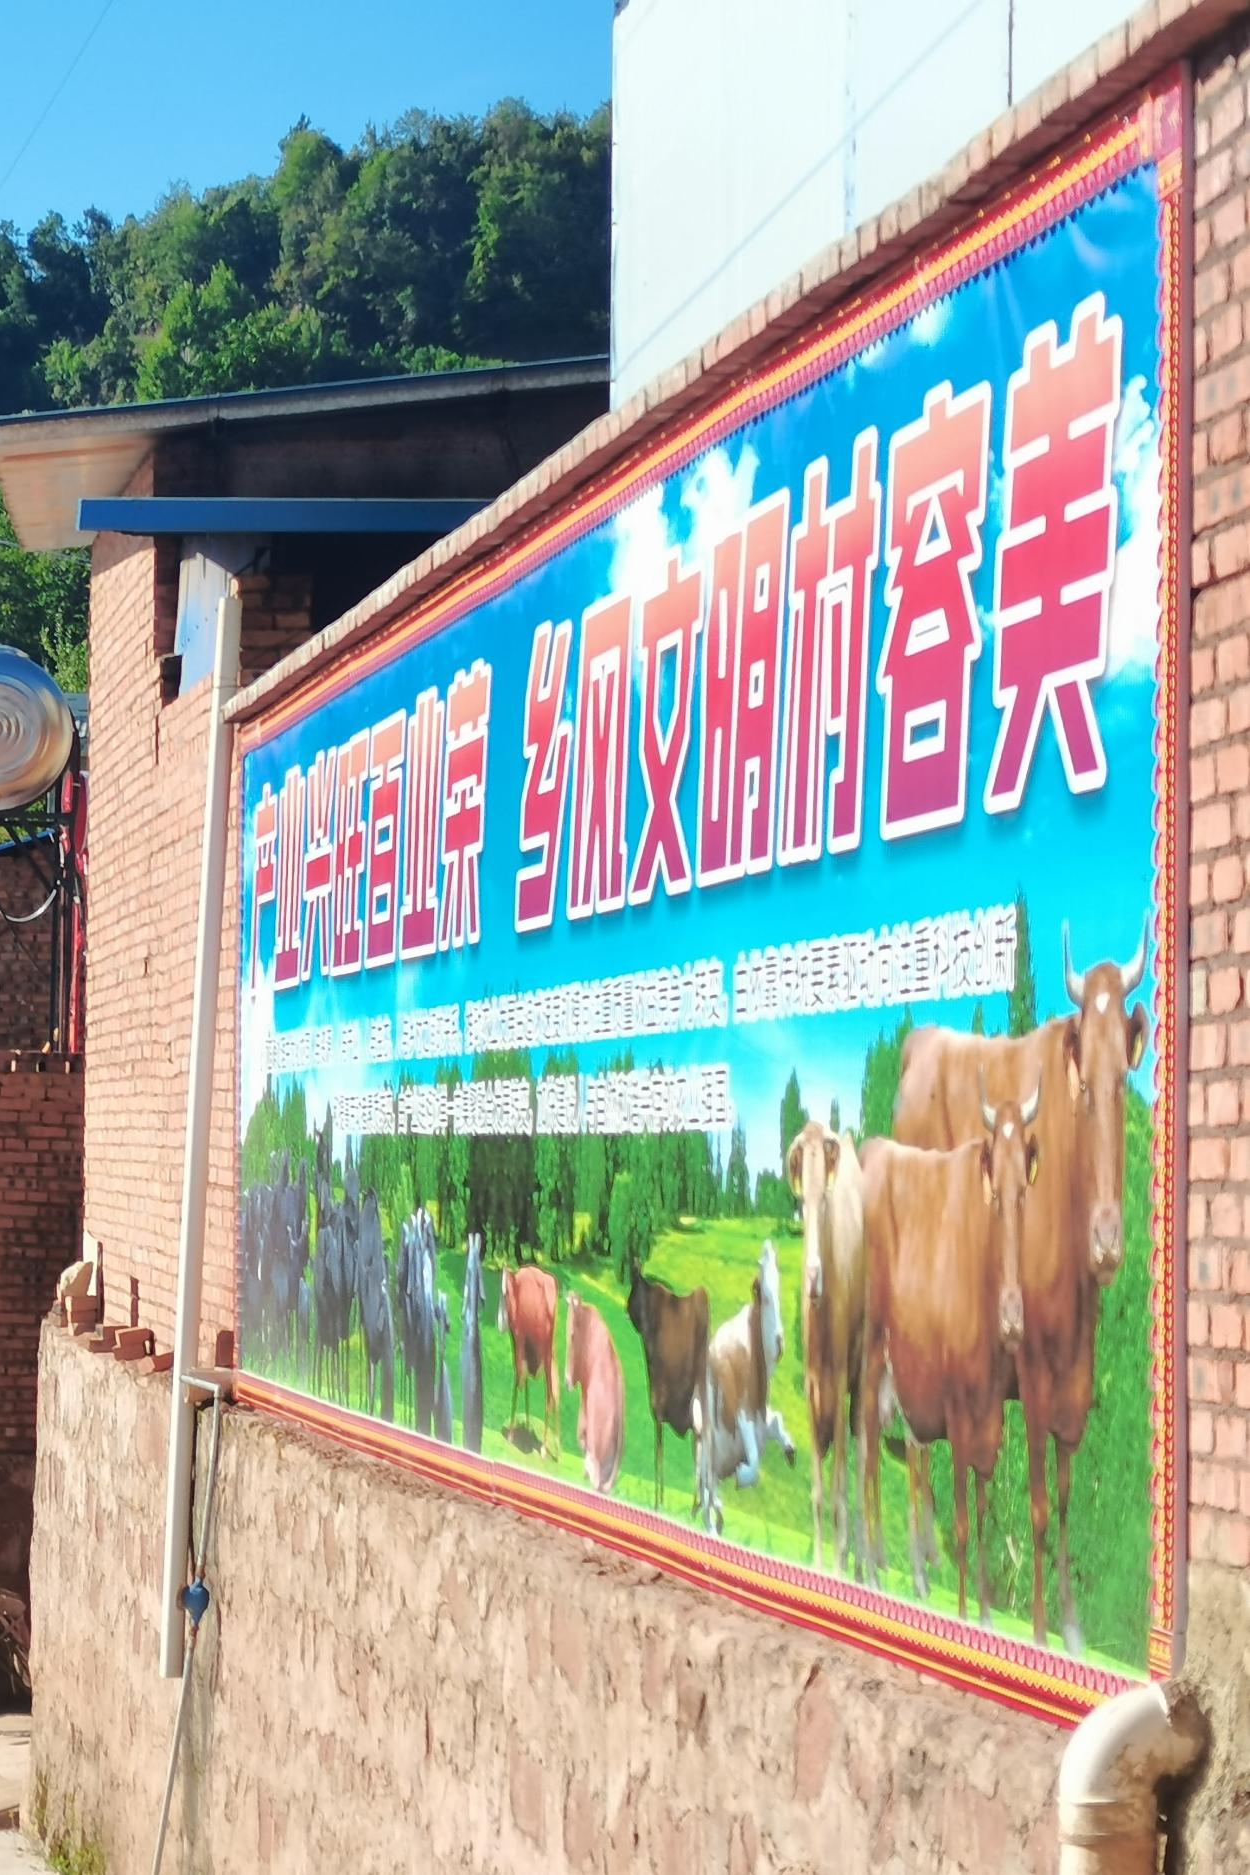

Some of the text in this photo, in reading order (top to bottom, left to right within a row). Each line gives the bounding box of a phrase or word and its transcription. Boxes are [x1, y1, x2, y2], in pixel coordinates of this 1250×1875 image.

[250, 291, 1122, 1000] 产业兴旺百业荣 乡风文明村容美
